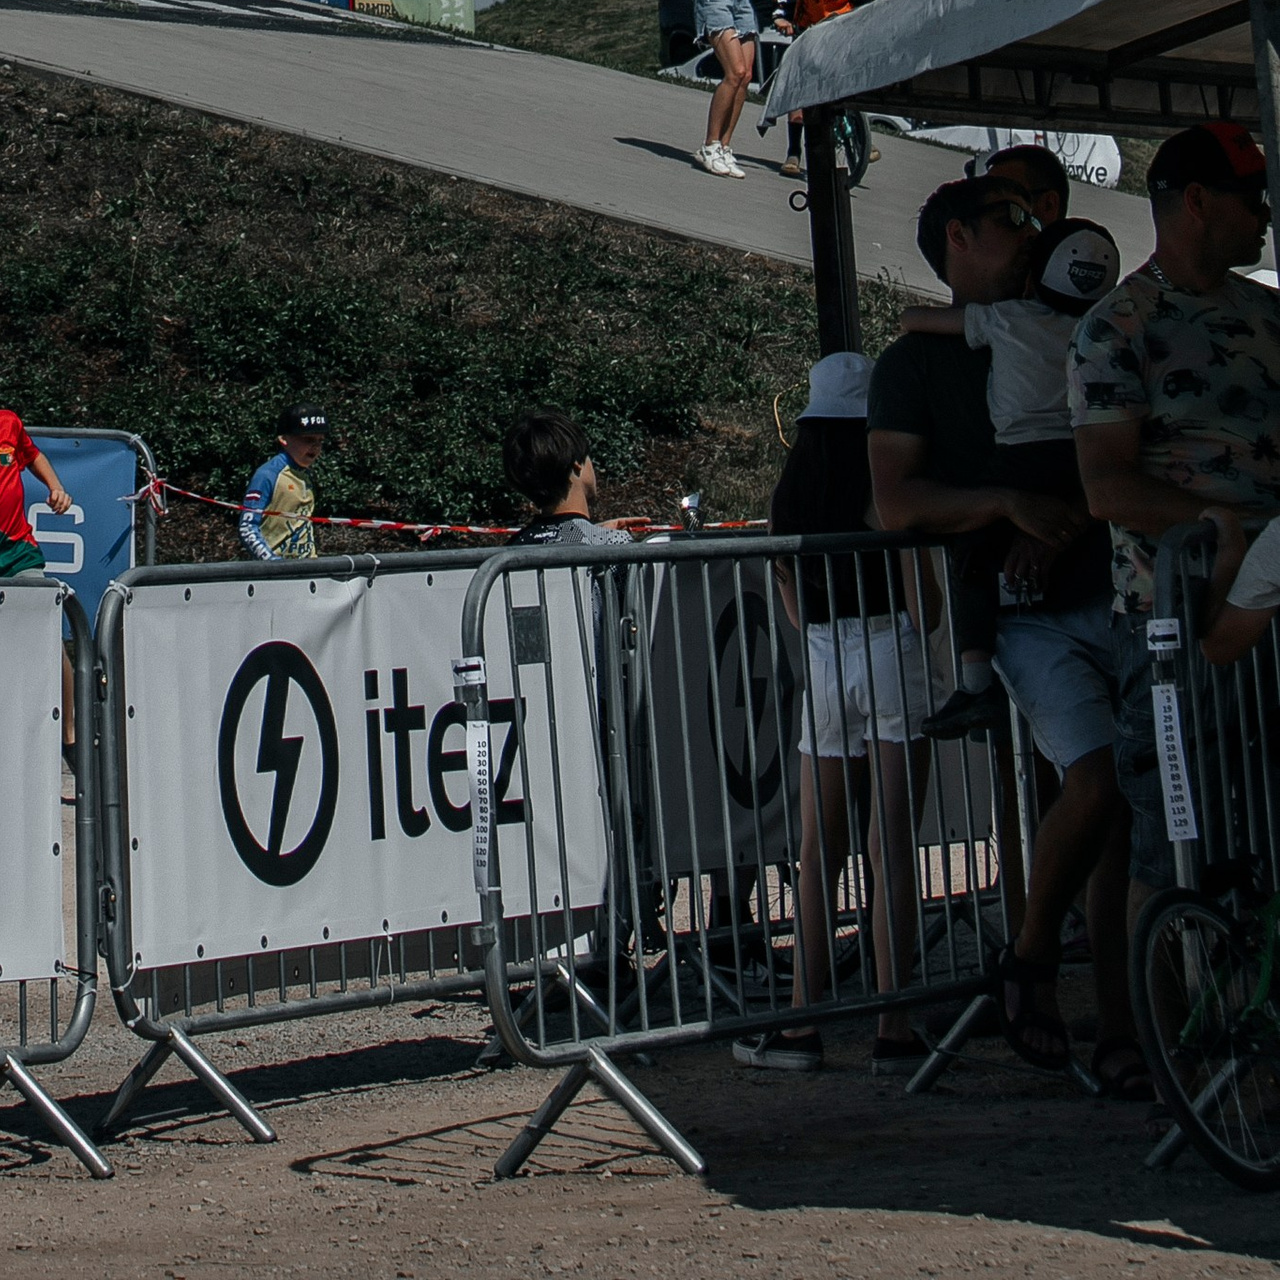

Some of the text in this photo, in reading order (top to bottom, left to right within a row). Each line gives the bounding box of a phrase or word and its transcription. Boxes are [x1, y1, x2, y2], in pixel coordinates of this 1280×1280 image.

[363, 667, 528, 842] itez
[1170, 794, 1184, 803] 109
[1172, 806, 1186, 815] 119
[1173, 818, 1188, 827] 129
